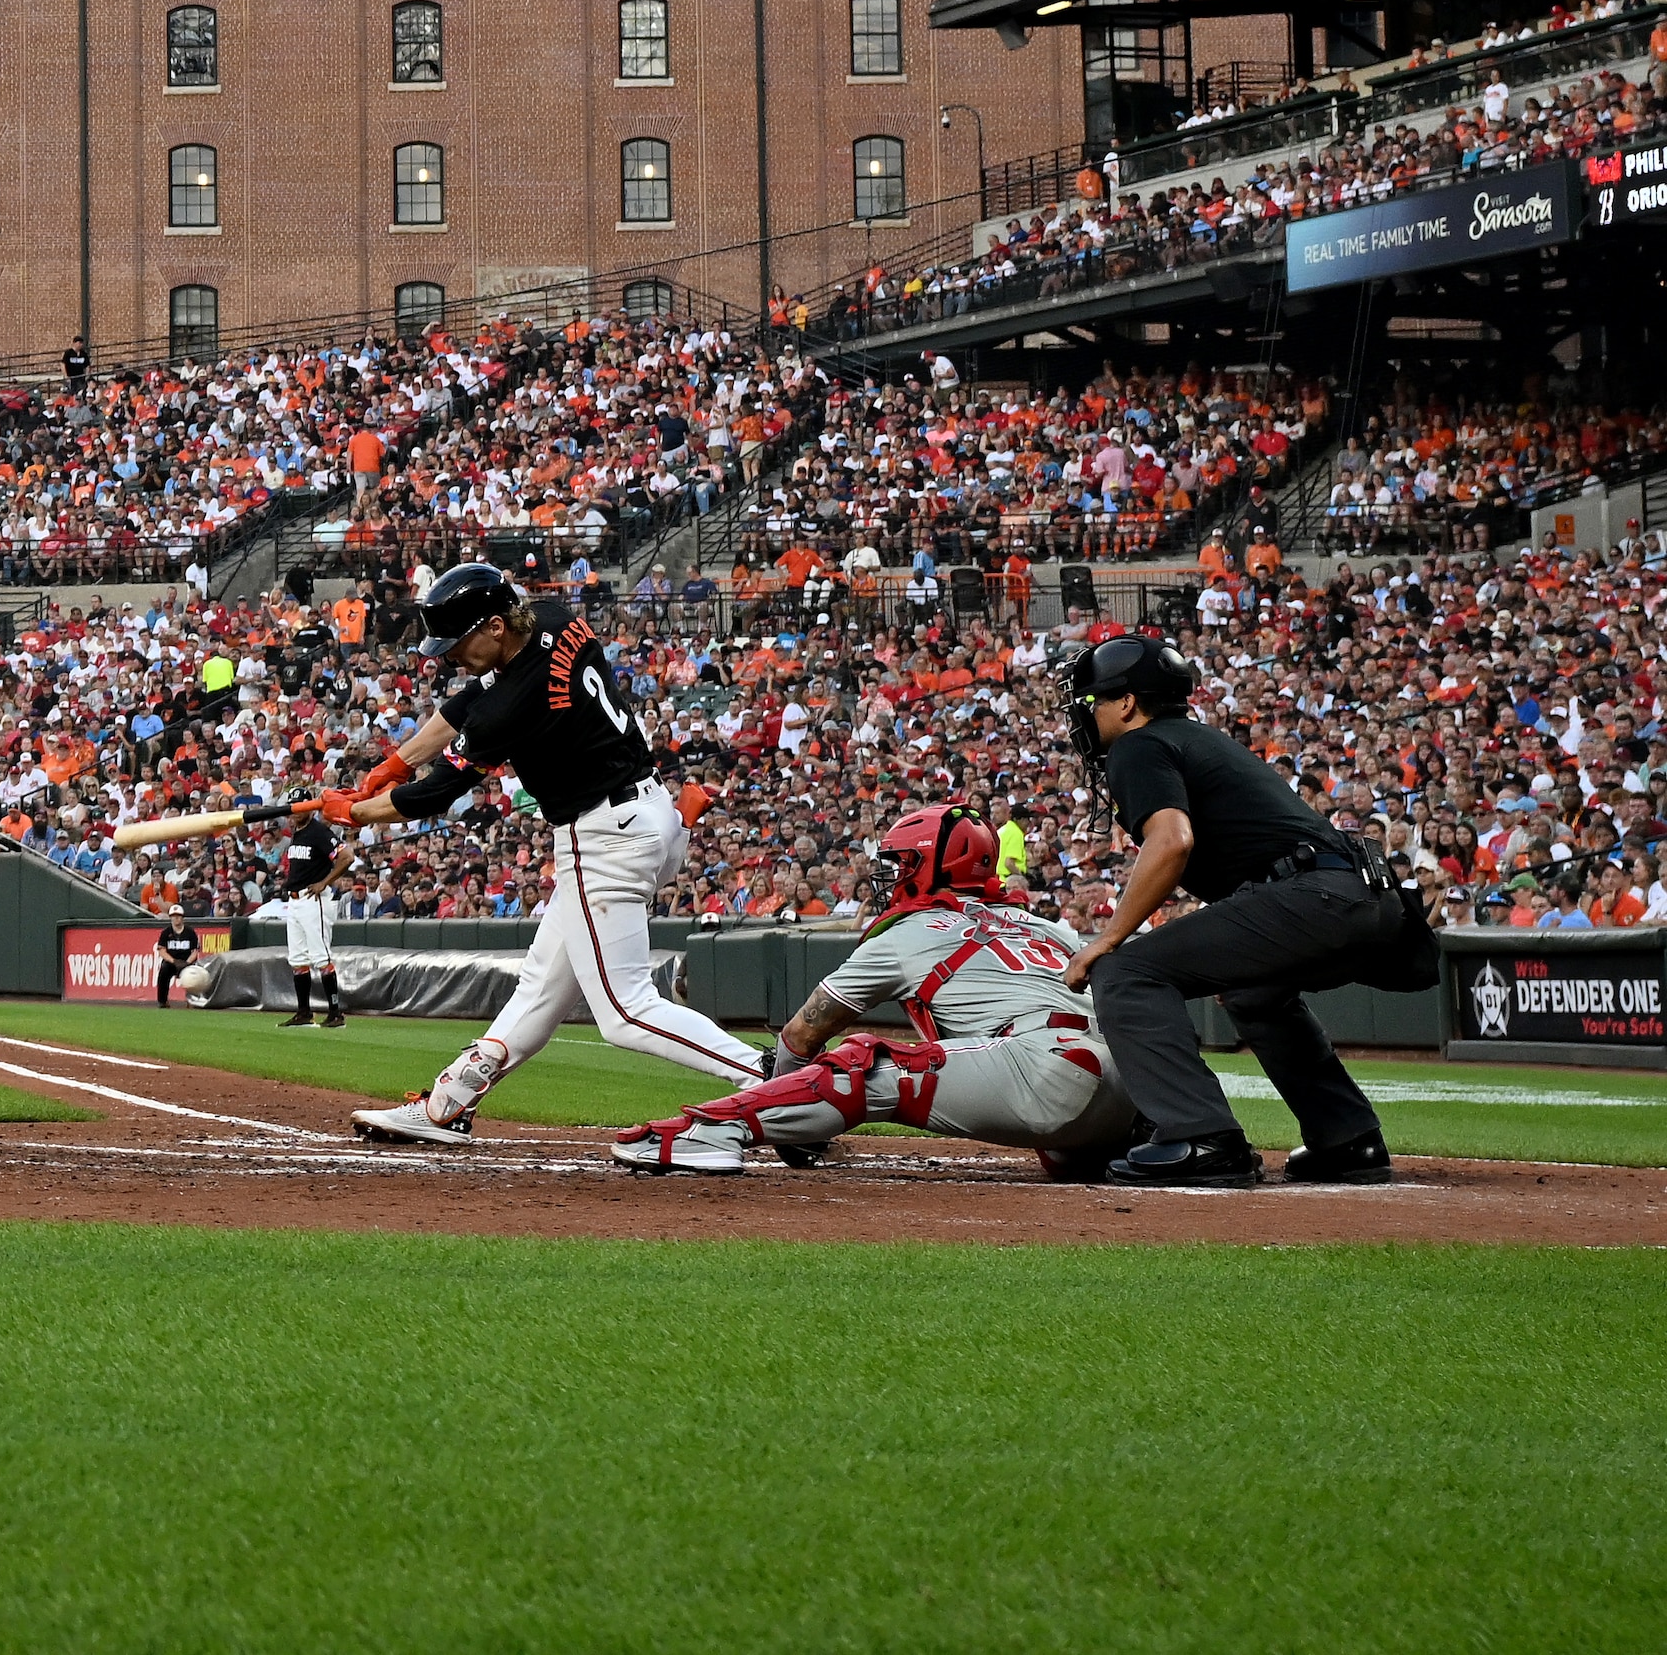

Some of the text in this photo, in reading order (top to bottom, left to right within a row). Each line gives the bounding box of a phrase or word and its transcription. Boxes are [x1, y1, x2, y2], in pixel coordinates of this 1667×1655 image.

[1468, 191, 1553, 241] Sarasota
[1627, 183, 1667, 212] ORIO
[1304, 216, 1451, 265] REAL TIME FAMILY TIME.
[548, 617, 597, 710] HENDERSO
[583, 666, 629, 735] 2
[68, 943, 110, 986] weis
[1515, 960, 1548, 977] With
[1486, 994, 1498, 1008] D1
[1516, 979, 1662, 1013] DEFENDER ONE
[1582, 1016, 1663, 1036] You're Safe
